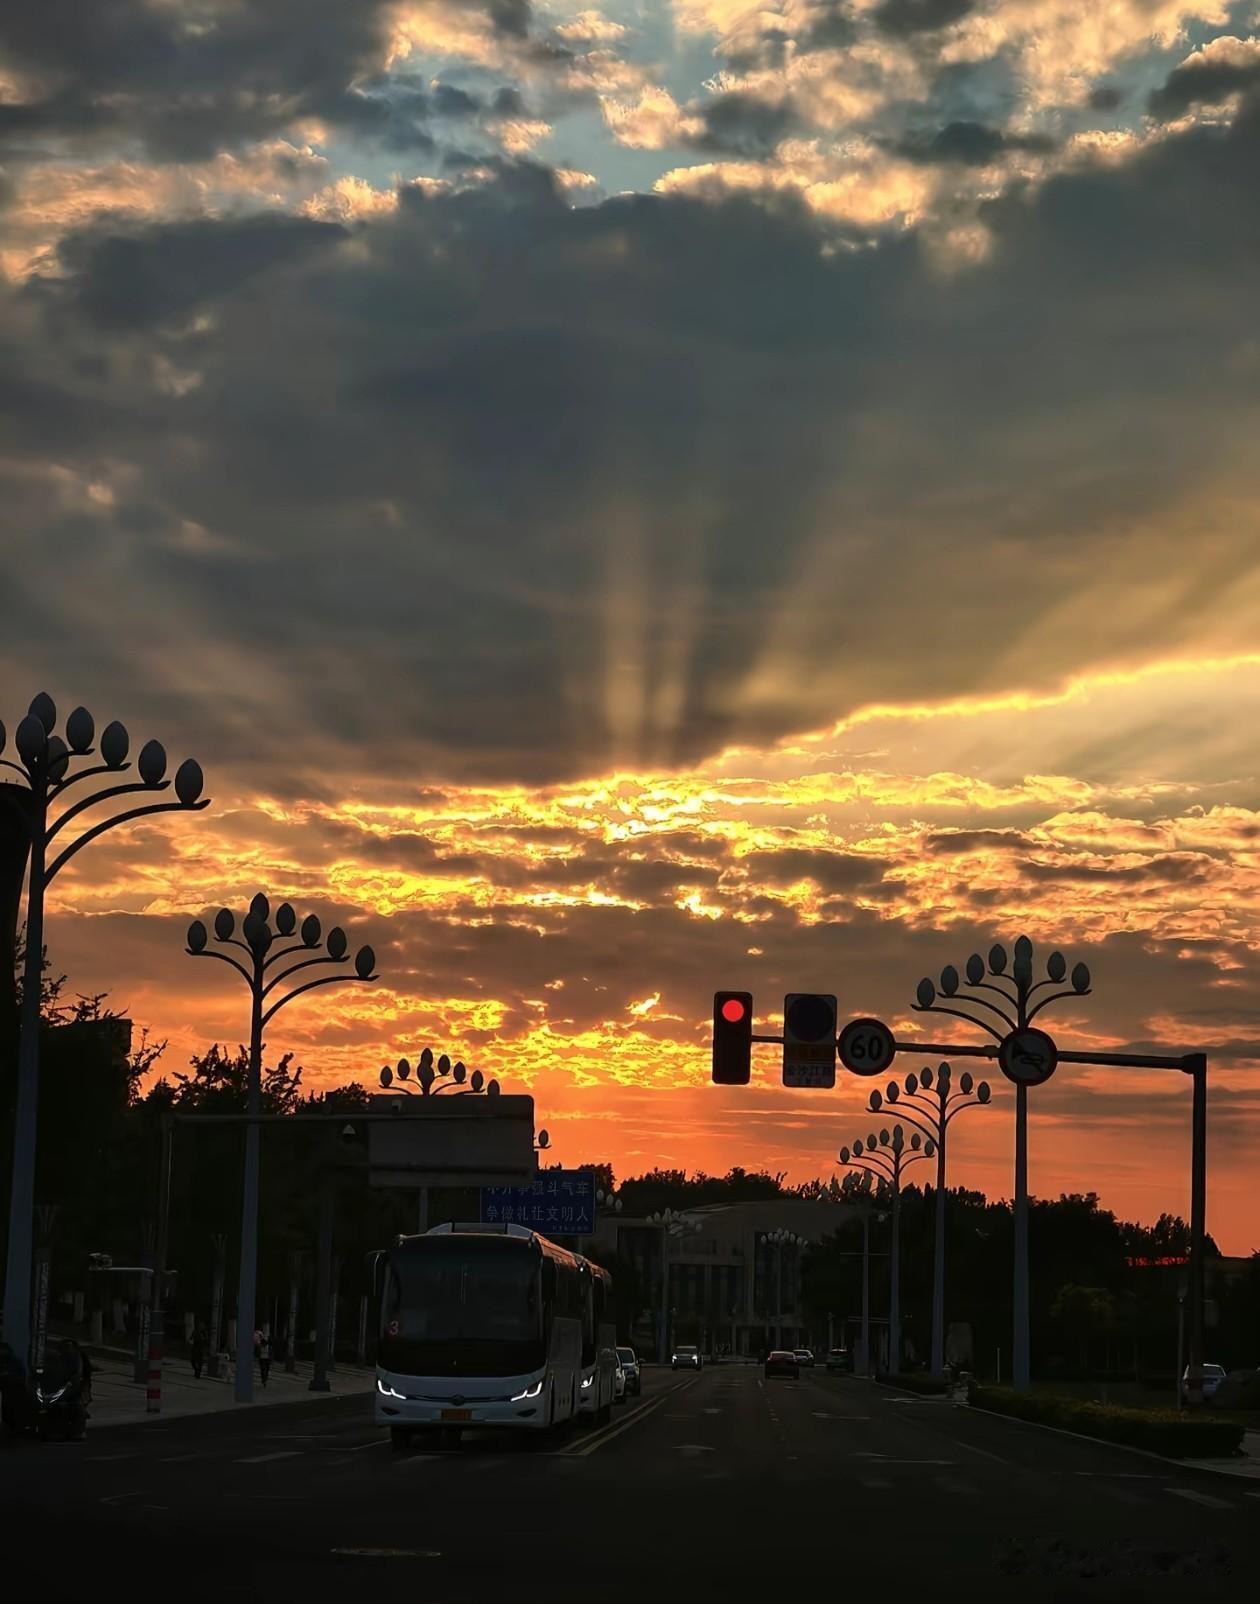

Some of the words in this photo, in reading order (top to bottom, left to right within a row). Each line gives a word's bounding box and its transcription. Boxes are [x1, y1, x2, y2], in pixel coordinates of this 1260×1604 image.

[851, 1035, 882, 1061] 60
[487, 1205, 589, 1222] 争做礼让文明人
[389, 1320, 399, 1335] 3
